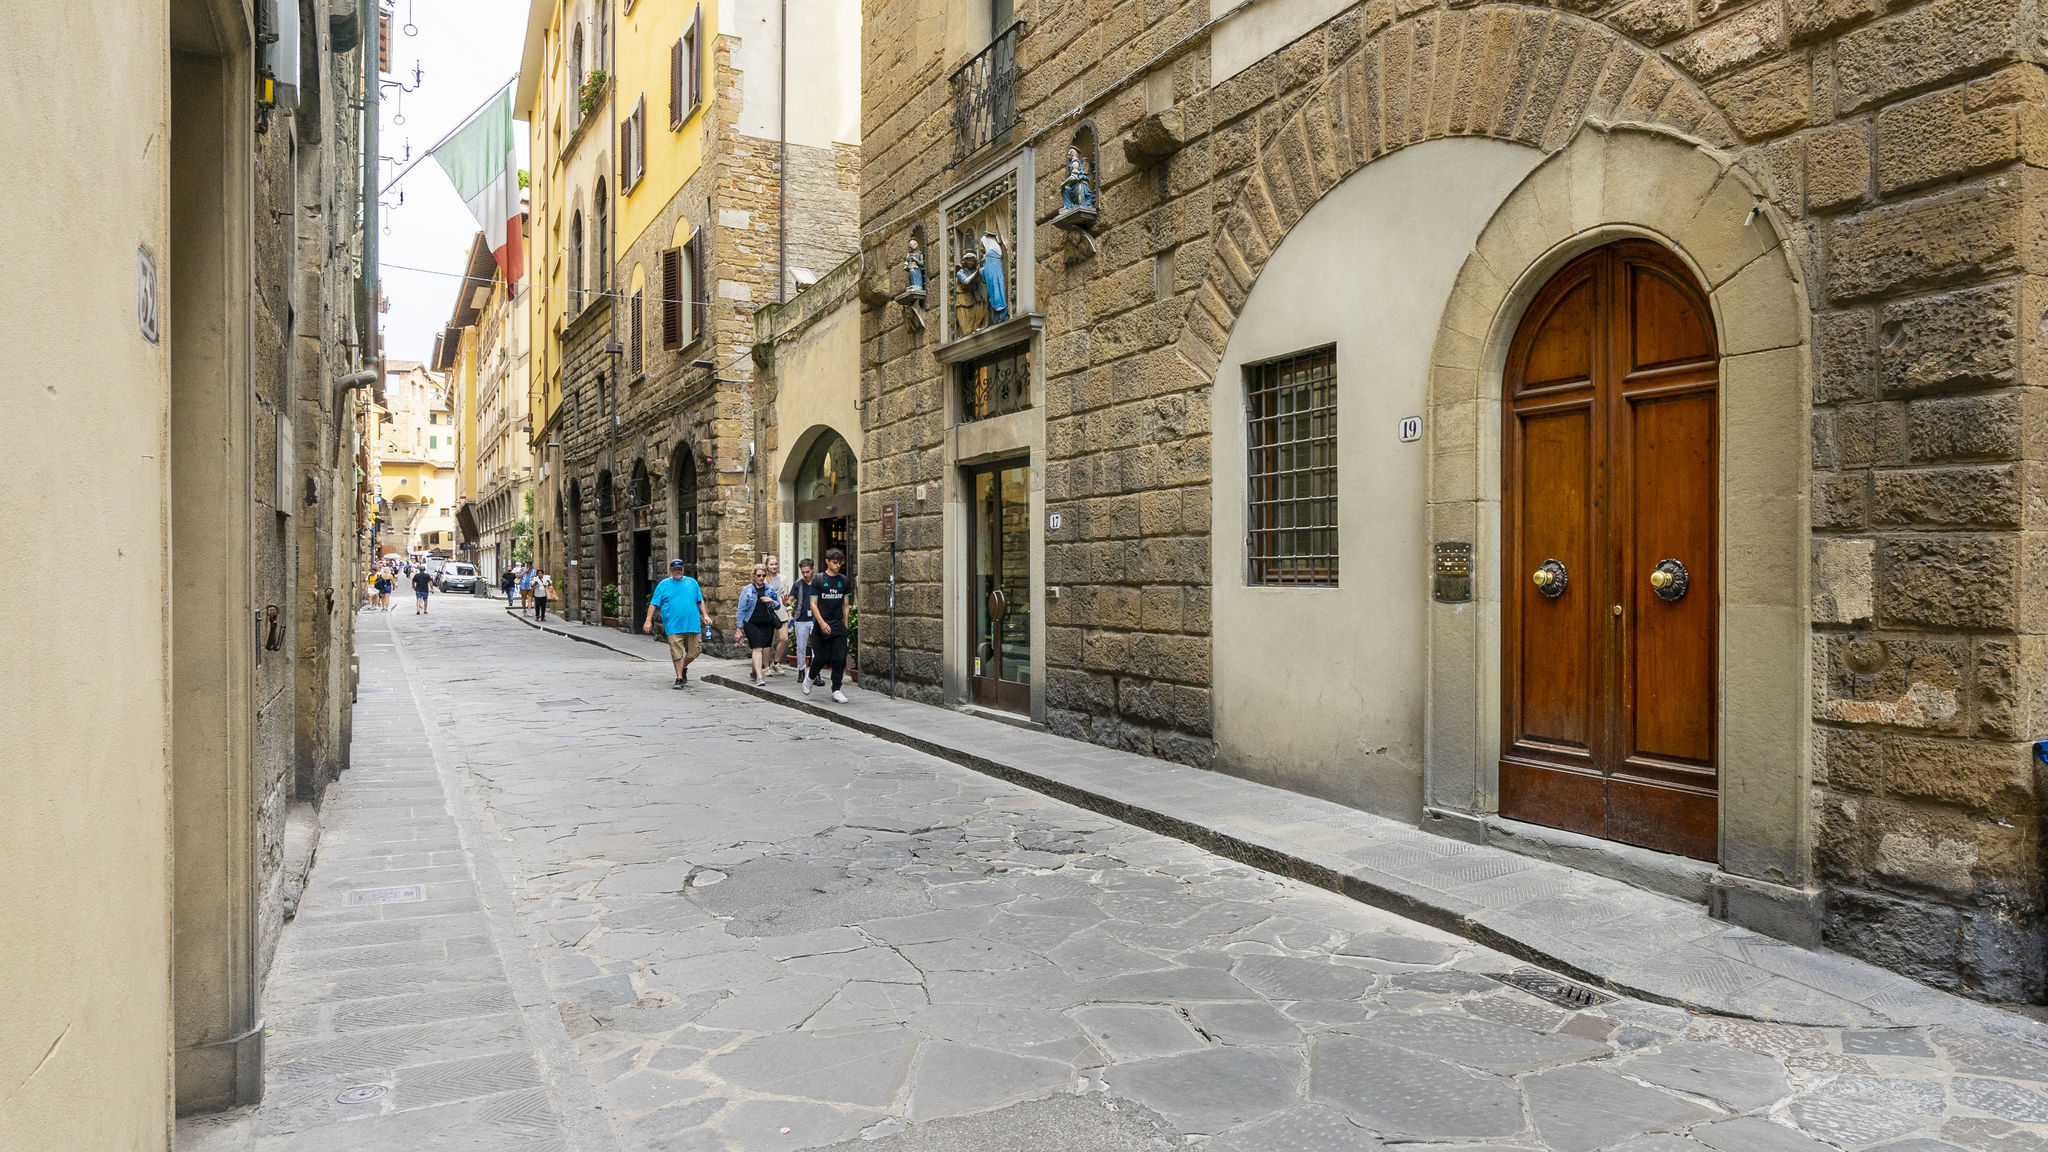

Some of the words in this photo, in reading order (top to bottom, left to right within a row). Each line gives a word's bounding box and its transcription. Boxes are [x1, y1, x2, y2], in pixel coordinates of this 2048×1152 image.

[1402, 420, 1417, 438] 19
[373, 496, 381, 504] P
[1051, 516, 1059, 528] 17
